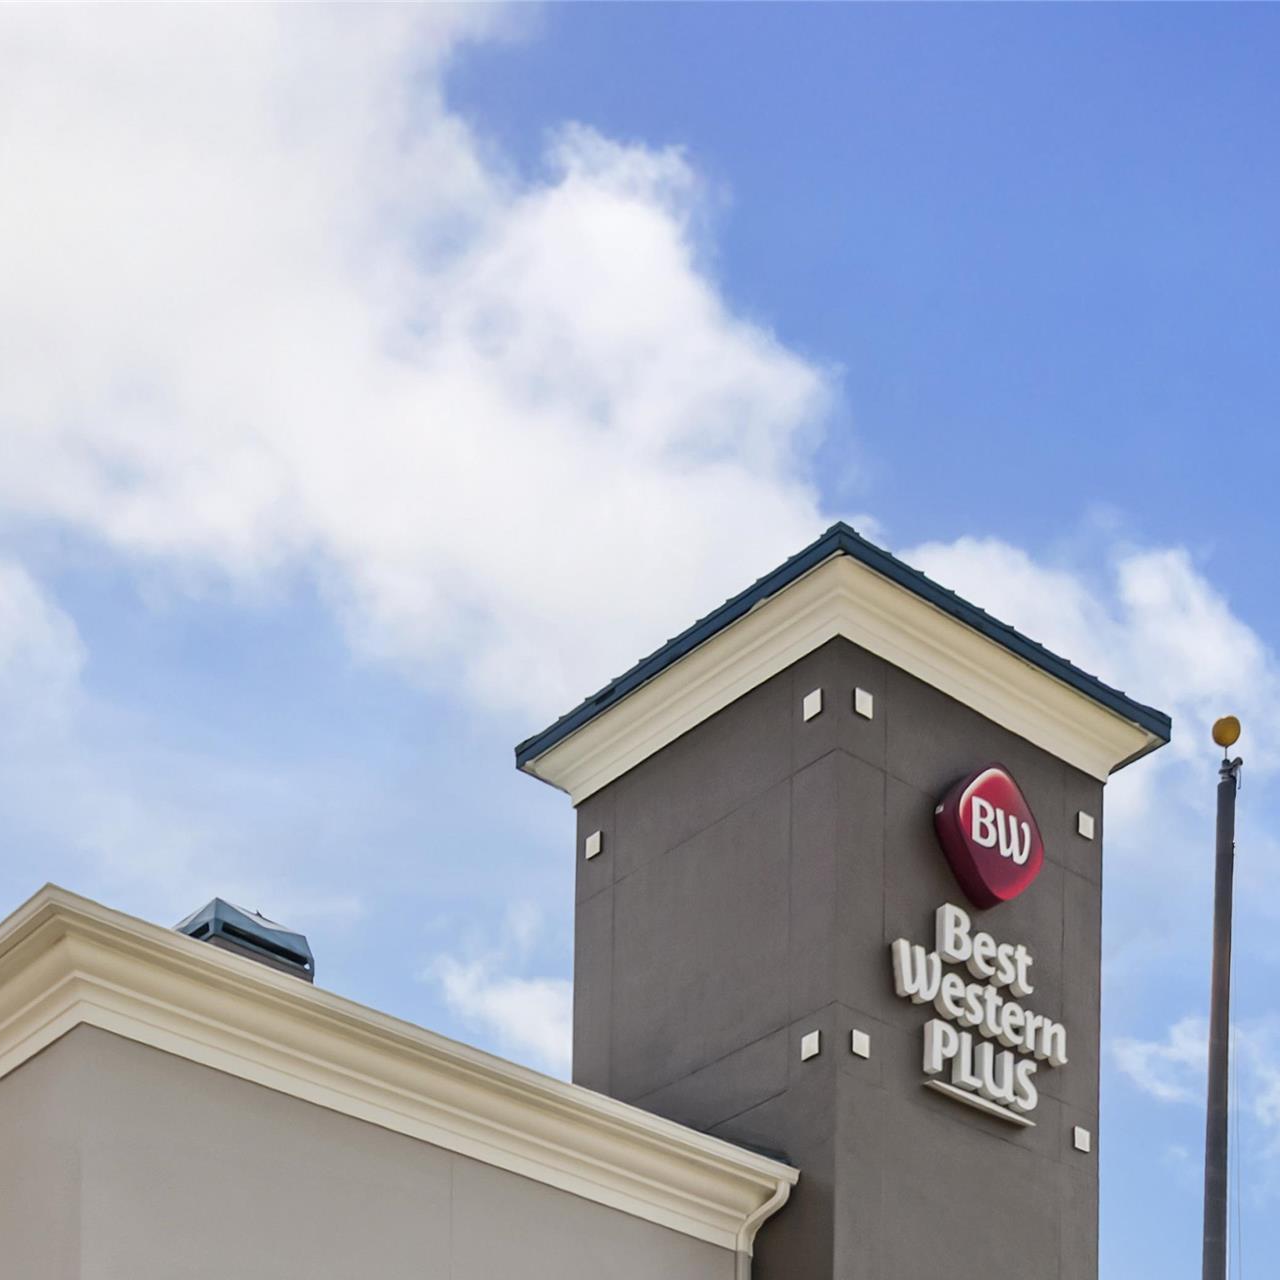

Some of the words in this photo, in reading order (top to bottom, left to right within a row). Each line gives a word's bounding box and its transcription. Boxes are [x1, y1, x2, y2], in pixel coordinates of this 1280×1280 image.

[971, 795, 1031, 865] BW
[936, 903, 1034, 997] Best
[891, 938, 1069, 1067] Western
